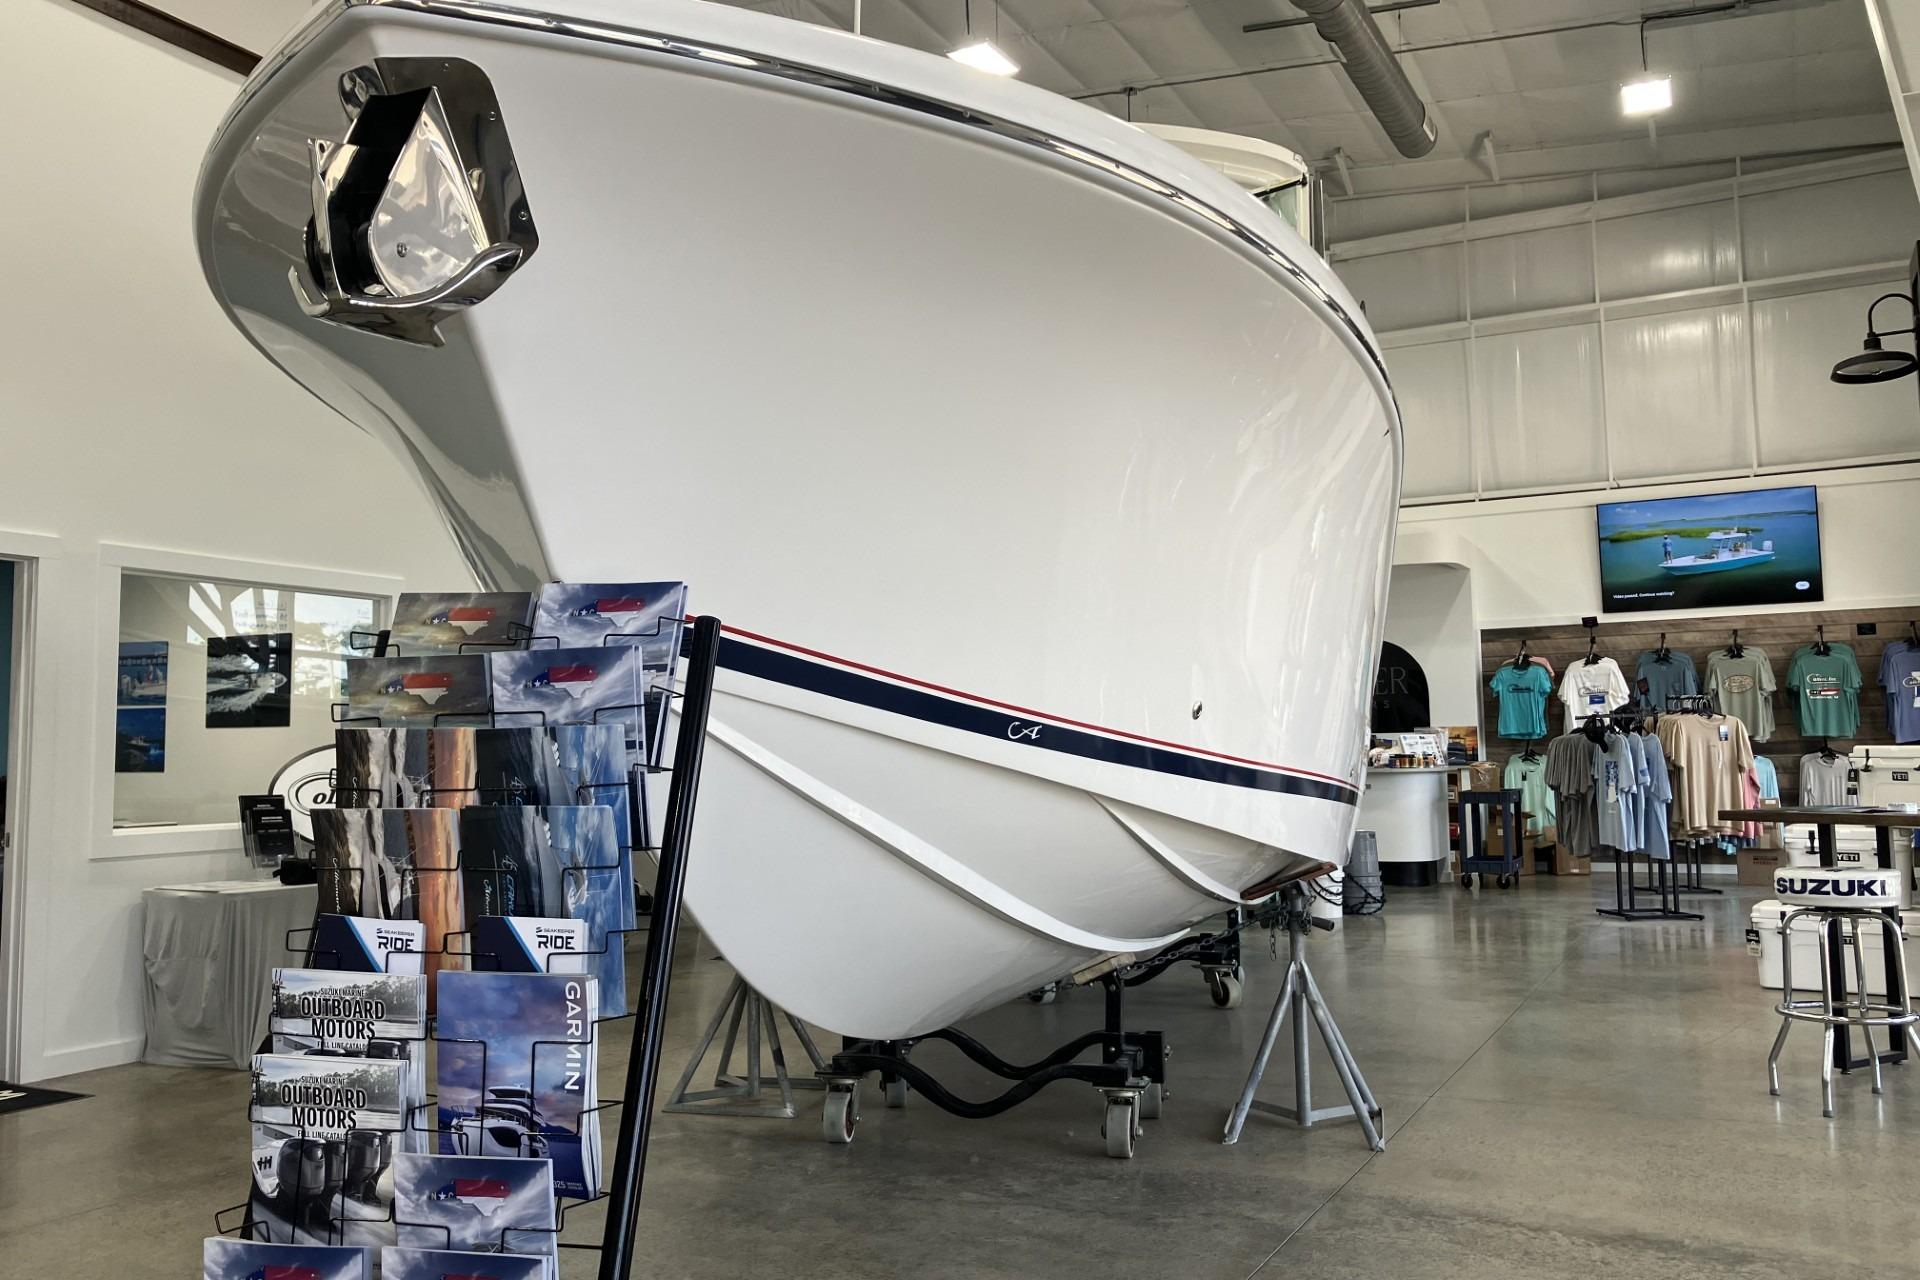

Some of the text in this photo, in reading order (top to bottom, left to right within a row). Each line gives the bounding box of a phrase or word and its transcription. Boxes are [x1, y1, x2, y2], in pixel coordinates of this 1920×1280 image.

[1892, 772, 1909, 781] YETI
[1837, 853, 1859, 862] YETI
[1776, 877, 1887, 897] SUZUKI
[384, 929, 415, 937] SEAKEEPER
[377, 936, 415, 951] RIDE
[537, 935, 576, 950] RIDE
[320, 987, 365, 998] SUZUKI MARINE
[302, 996, 385, 1019] OUTBOARD
[312, 1019, 375, 1040] MOTORS
[564, 981, 582, 1091] GARMIN
[317, 1040, 330, 1049] FLL
[301, 1075, 346, 1086] SUZUKI MARINE
[282, 1084, 366, 1109] OUTBOARD
[292, 1107, 356, 1129] MOTORS
[297, 1129, 310, 1138] FLL
